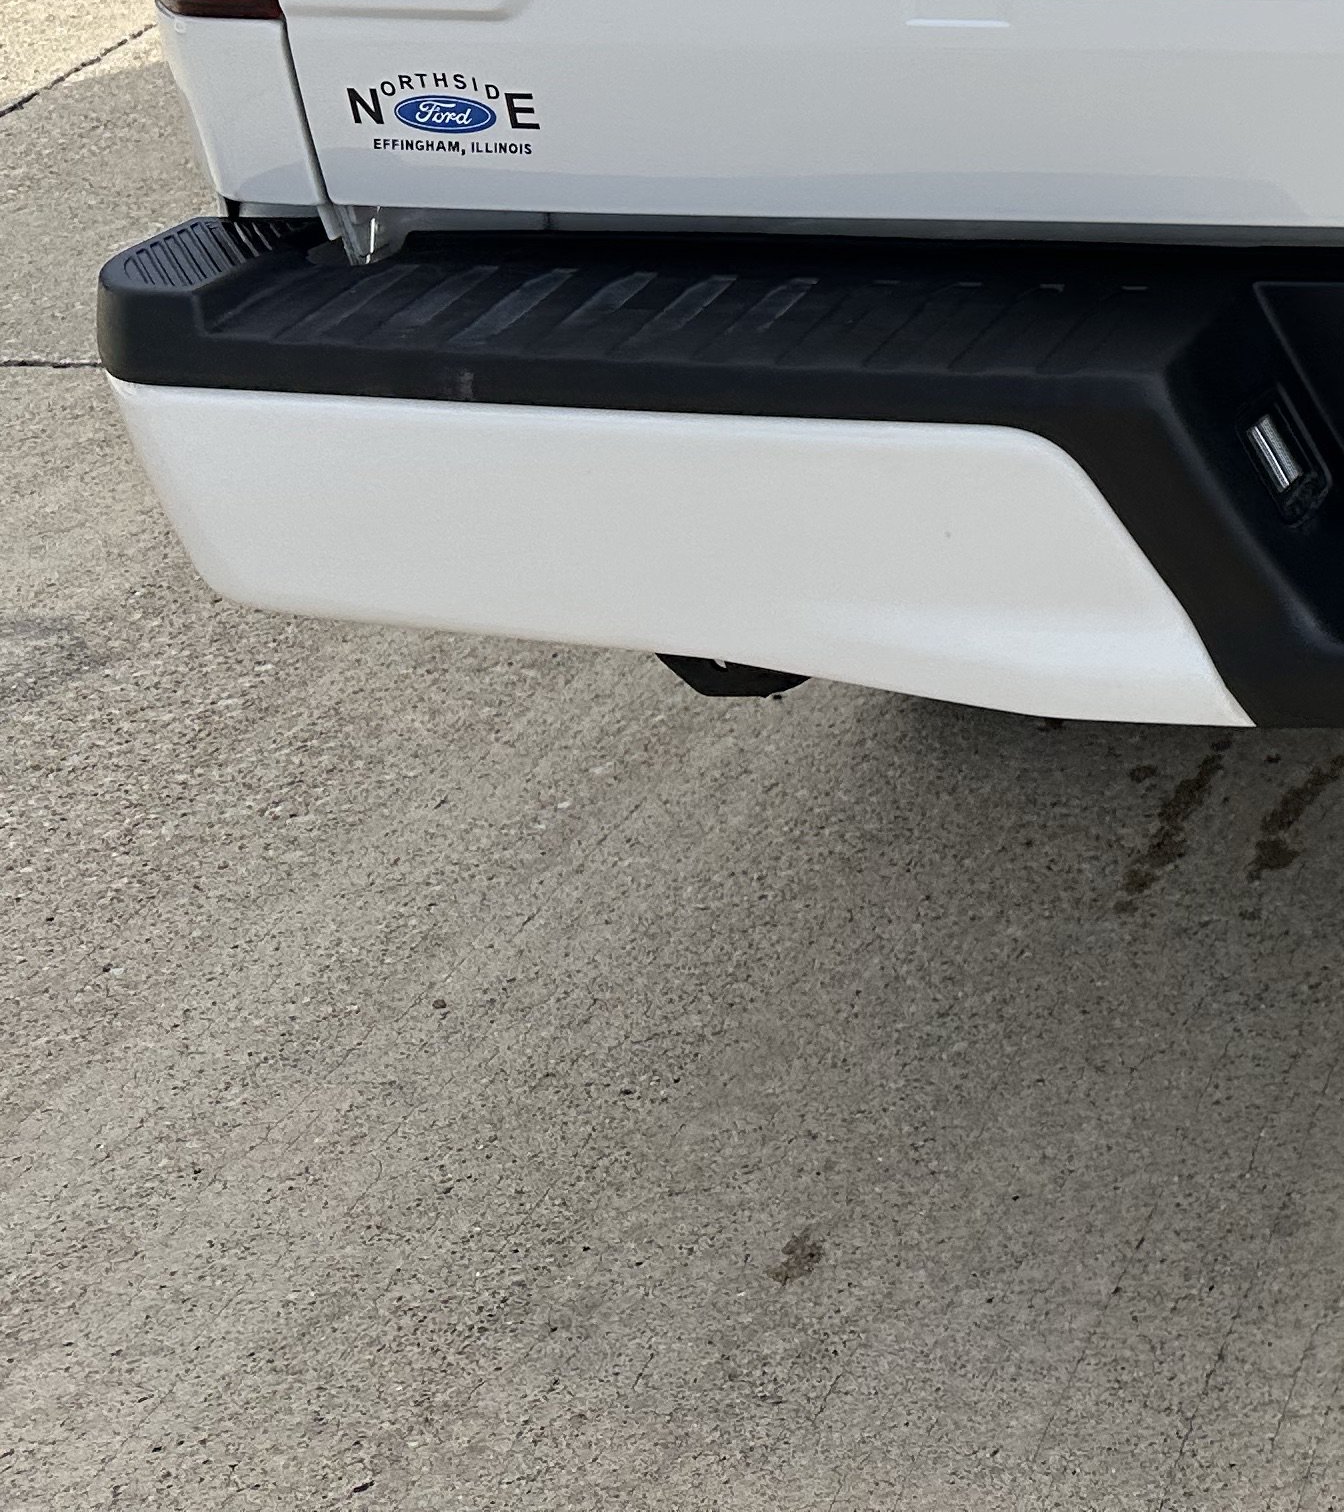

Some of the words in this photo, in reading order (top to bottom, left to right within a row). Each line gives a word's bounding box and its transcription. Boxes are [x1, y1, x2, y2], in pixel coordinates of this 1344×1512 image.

[347, 72, 540, 130] NORTHSIDE
[415, 100, 472, 125] Ford
[373, 138, 466, 156] EFFINGHAM,
[471, 141, 532, 155] ILLINOIS
